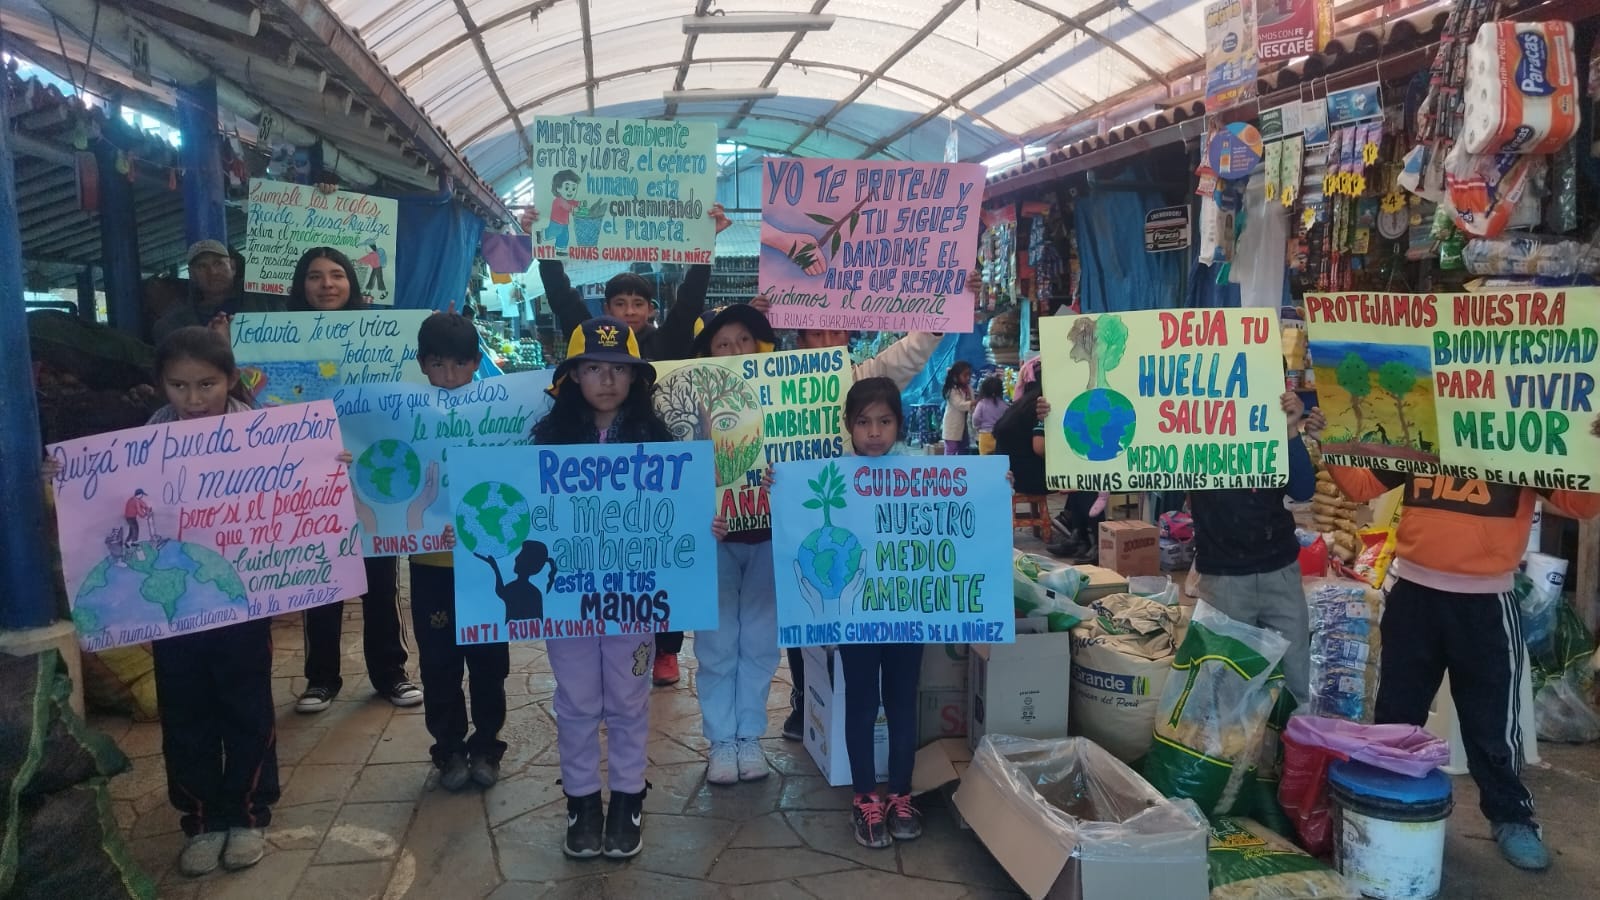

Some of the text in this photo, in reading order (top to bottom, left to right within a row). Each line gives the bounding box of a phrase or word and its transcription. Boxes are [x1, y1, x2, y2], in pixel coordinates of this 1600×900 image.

[1521, 33, 1544, 93] Paracas
[605, 119, 620, 145] el
[622, 119, 690, 148] ambiente
[637, 148, 654, 171] el
[586, 172, 680, 200] humano esta
[767, 161, 805, 206] YO
[609, 188, 703, 219] contaminando
[602, 215, 618, 235] el
[861, 208, 889, 235] TU
[533, 245, 556, 259] INTI
[568, 246, 600, 260] RUNAS
[602, 246, 659, 262] GUARDIANES
[684, 247, 712, 263] NIÑEZ
[842, 237, 960, 269] DANDOME EL
[261, 281, 284, 293] RUNAS
[840, 289, 857, 310] el
[861, 290, 946, 315] ambiente
[783, 313, 815, 328] RUNAS
[819, 314, 874, 329] GUARDIANES
[878, 316, 889, 329] DE
[893, 316, 907, 330] LA
[1306, 291, 1566, 328] PROTEJAMOS NUESTRA
[359, 315, 401, 338] viva
[1158, 310, 1269, 349] DEJA TU
[1432, 327, 1599, 366] BIODIVERSIDAD
[743, 350, 844, 380] SI CUIDAMOS
[1138, 351, 1249, 398] HUELLA
[406, 391, 431, 417] que
[760, 375, 840, 406] EL MEDIO
[1436, 369, 1595, 413] PARA VIVIR
[411, 406, 534, 443] le estas dando
[764, 406, 841, 438] AMBIENTE
[1158, 399, 1269, 436] SALVA EL
[1453, 410, 1570, 456] MEJOR
[161, 416, 241, 475] pueda
[764, 436, 844, 463] VIVIREMOS
[1127, 439, 1279, 476] MEDIO AMBIENTE
[161, 465, 187, 505] al
[539, 444, 693, 494] Respetar
[853, 466, 968, 497] CUIDEMOS
[1047, 472, 1288, 491] INTI RUNAS GUARDIANES DE LA NIÑEZ
[1324, 453, 1591, 491] INTI RUNAS GUARDIANES DE LA NIÑEZ
[178, 500, 224, 540] pero
[246, 493, 265, 521] el
[272, 465, 349, 529] pedacito
[1413, 476, 1491, 505] FILA
[531, 488, 675, 534] el medio
[874, 501, 976, 538] NUESTRO
[215, 528, 243, 555] que
[233, 523, 360, 573] Cuidemos el
[373, 534, 418, 554] RUNAS
[552, 530, 696, 573] ambiente
[875, 539, 957, 572] MEDIO
[554, 568, 597, 593] esta
[862, 574, 985, 614] AMBIENTE
[247, 594, 263, 618] de
[266, 595, 282, 613] la
[580, 589, 671, 623] Manos
[461, 617, 670, 643] INTI RUNAKUNAQ WASIN
[780, 618, 1004, 645] INTI RUNAS GUARDIANES DE LA NIÑEZ
